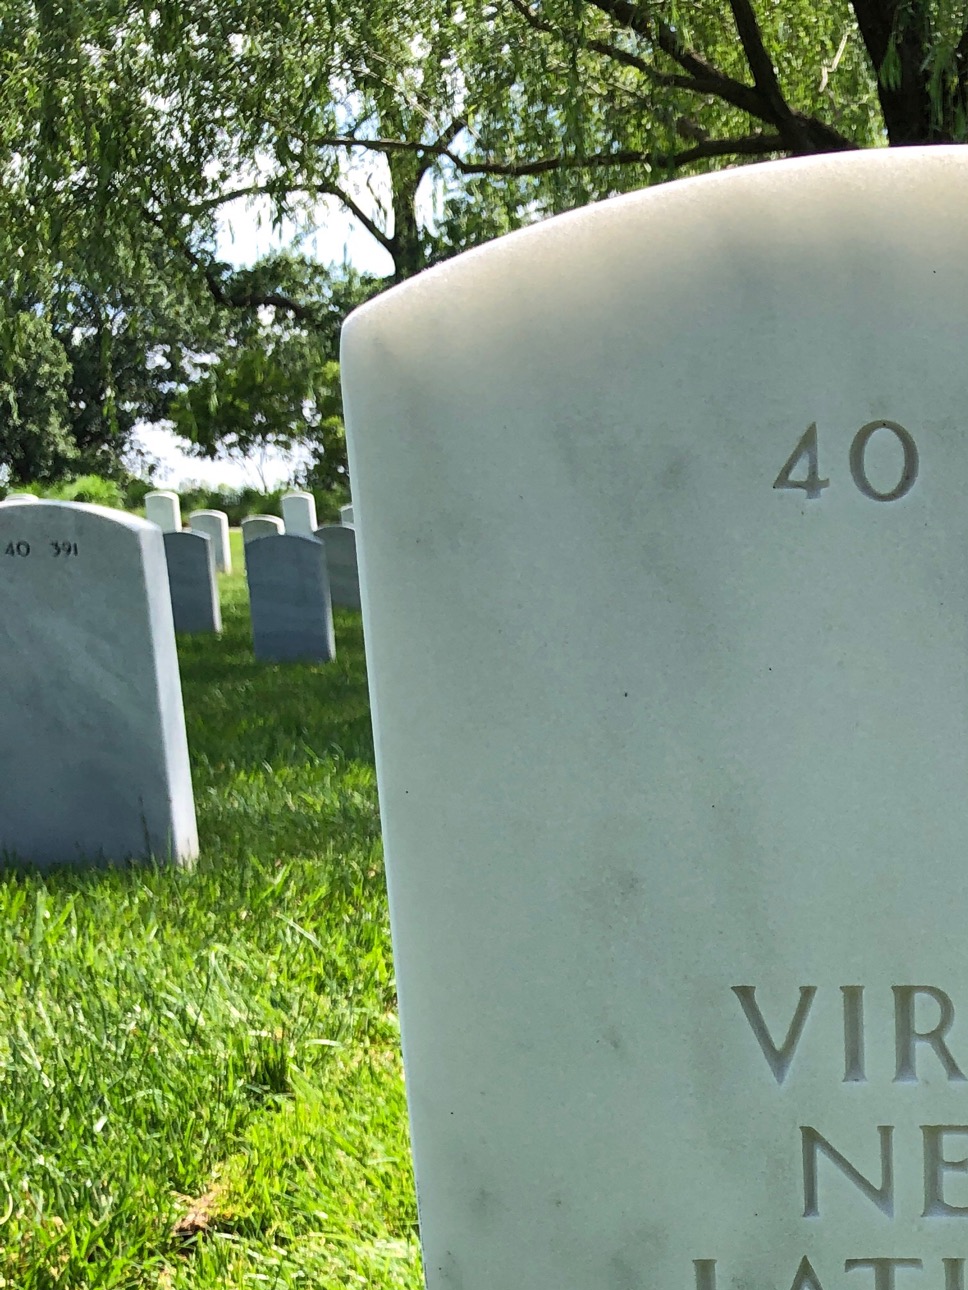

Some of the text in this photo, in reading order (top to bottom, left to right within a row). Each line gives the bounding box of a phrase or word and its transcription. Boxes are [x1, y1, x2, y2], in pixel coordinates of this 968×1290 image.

[773, 419, 920, 503] 40
[5, 541, 78, 558] 40 391
